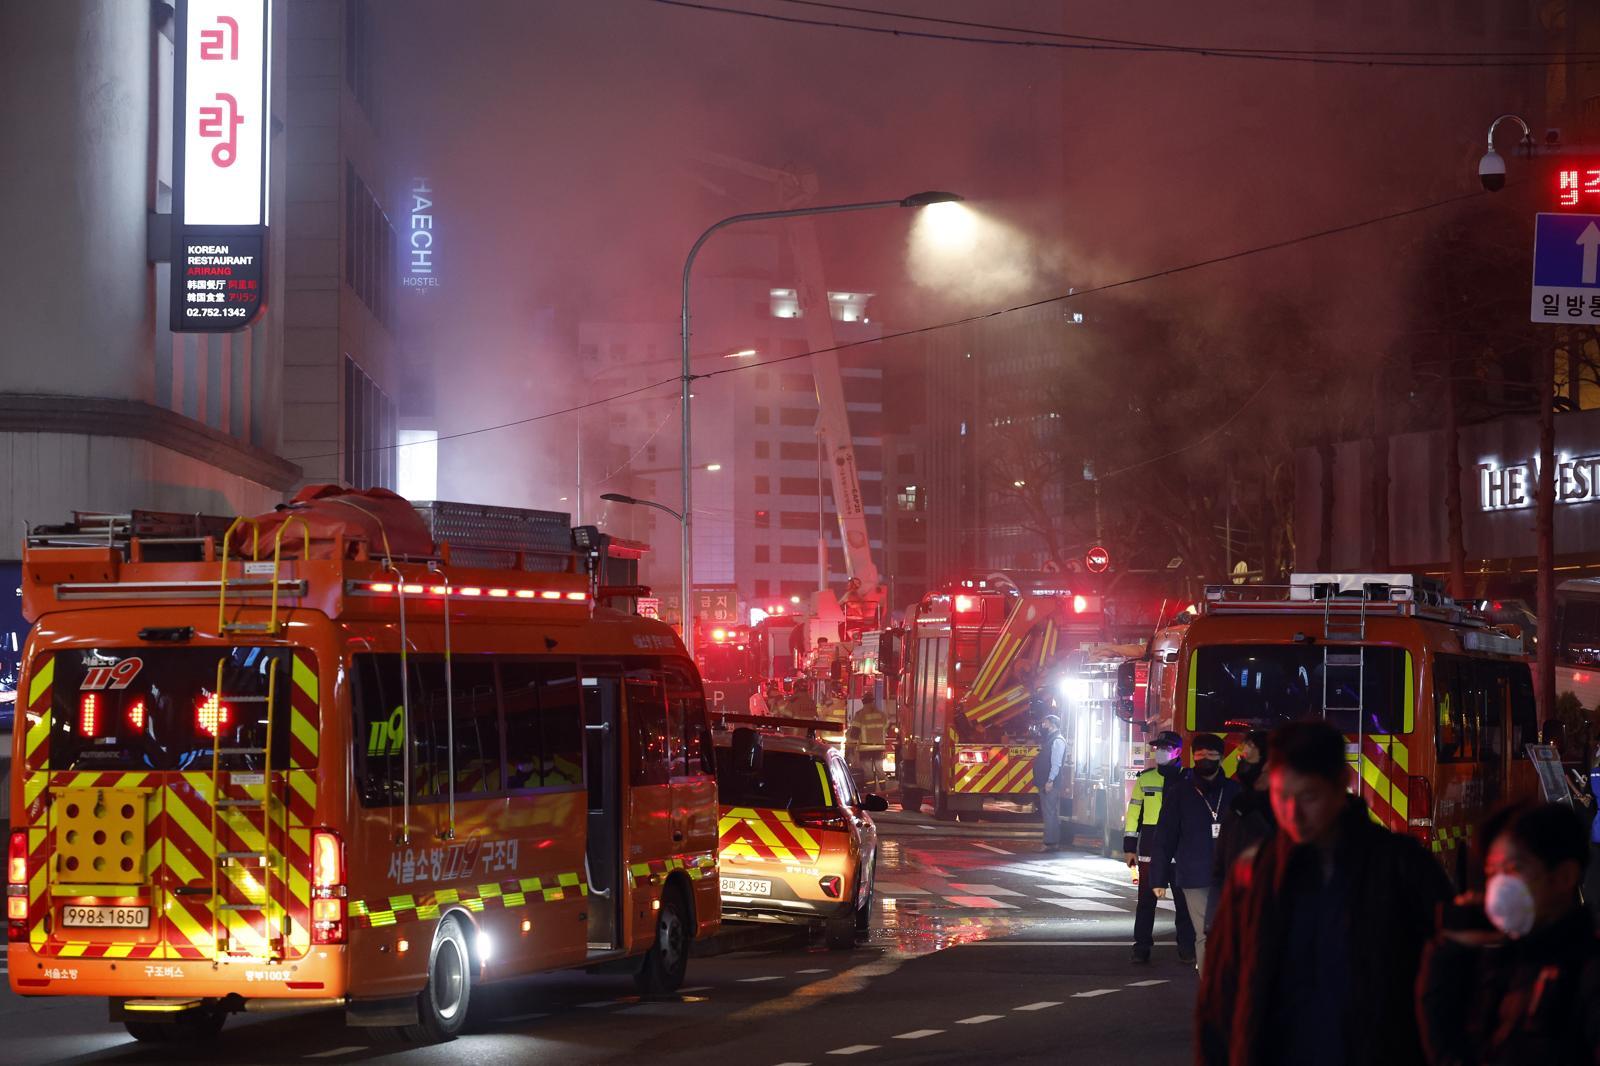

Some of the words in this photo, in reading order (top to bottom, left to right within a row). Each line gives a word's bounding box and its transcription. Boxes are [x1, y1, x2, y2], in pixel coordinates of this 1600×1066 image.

[411, 177, 433, 273] HAECHI
[187, 245, 229, 254] KOREAN
[187, 256, 253, 265] RESTAURANT
[187, 267, 232, 276] ARIRANG
[403, 277, 440, 286] HOSTEL
[186, 307, 246, 317] 02.752.1342
[1472, 461, 1526, 510] THE
[80, 657, 144, 690] 119
[367, 705, 404, 756] 119
[387, 847, 443, 885] 서울소방
[481, 839, 519, 874] 구조대
[738, 880, 768, 893] 2395
[44, 968, 78, 980] 서울소방
[144, 966, 184, 978] 구조버스
